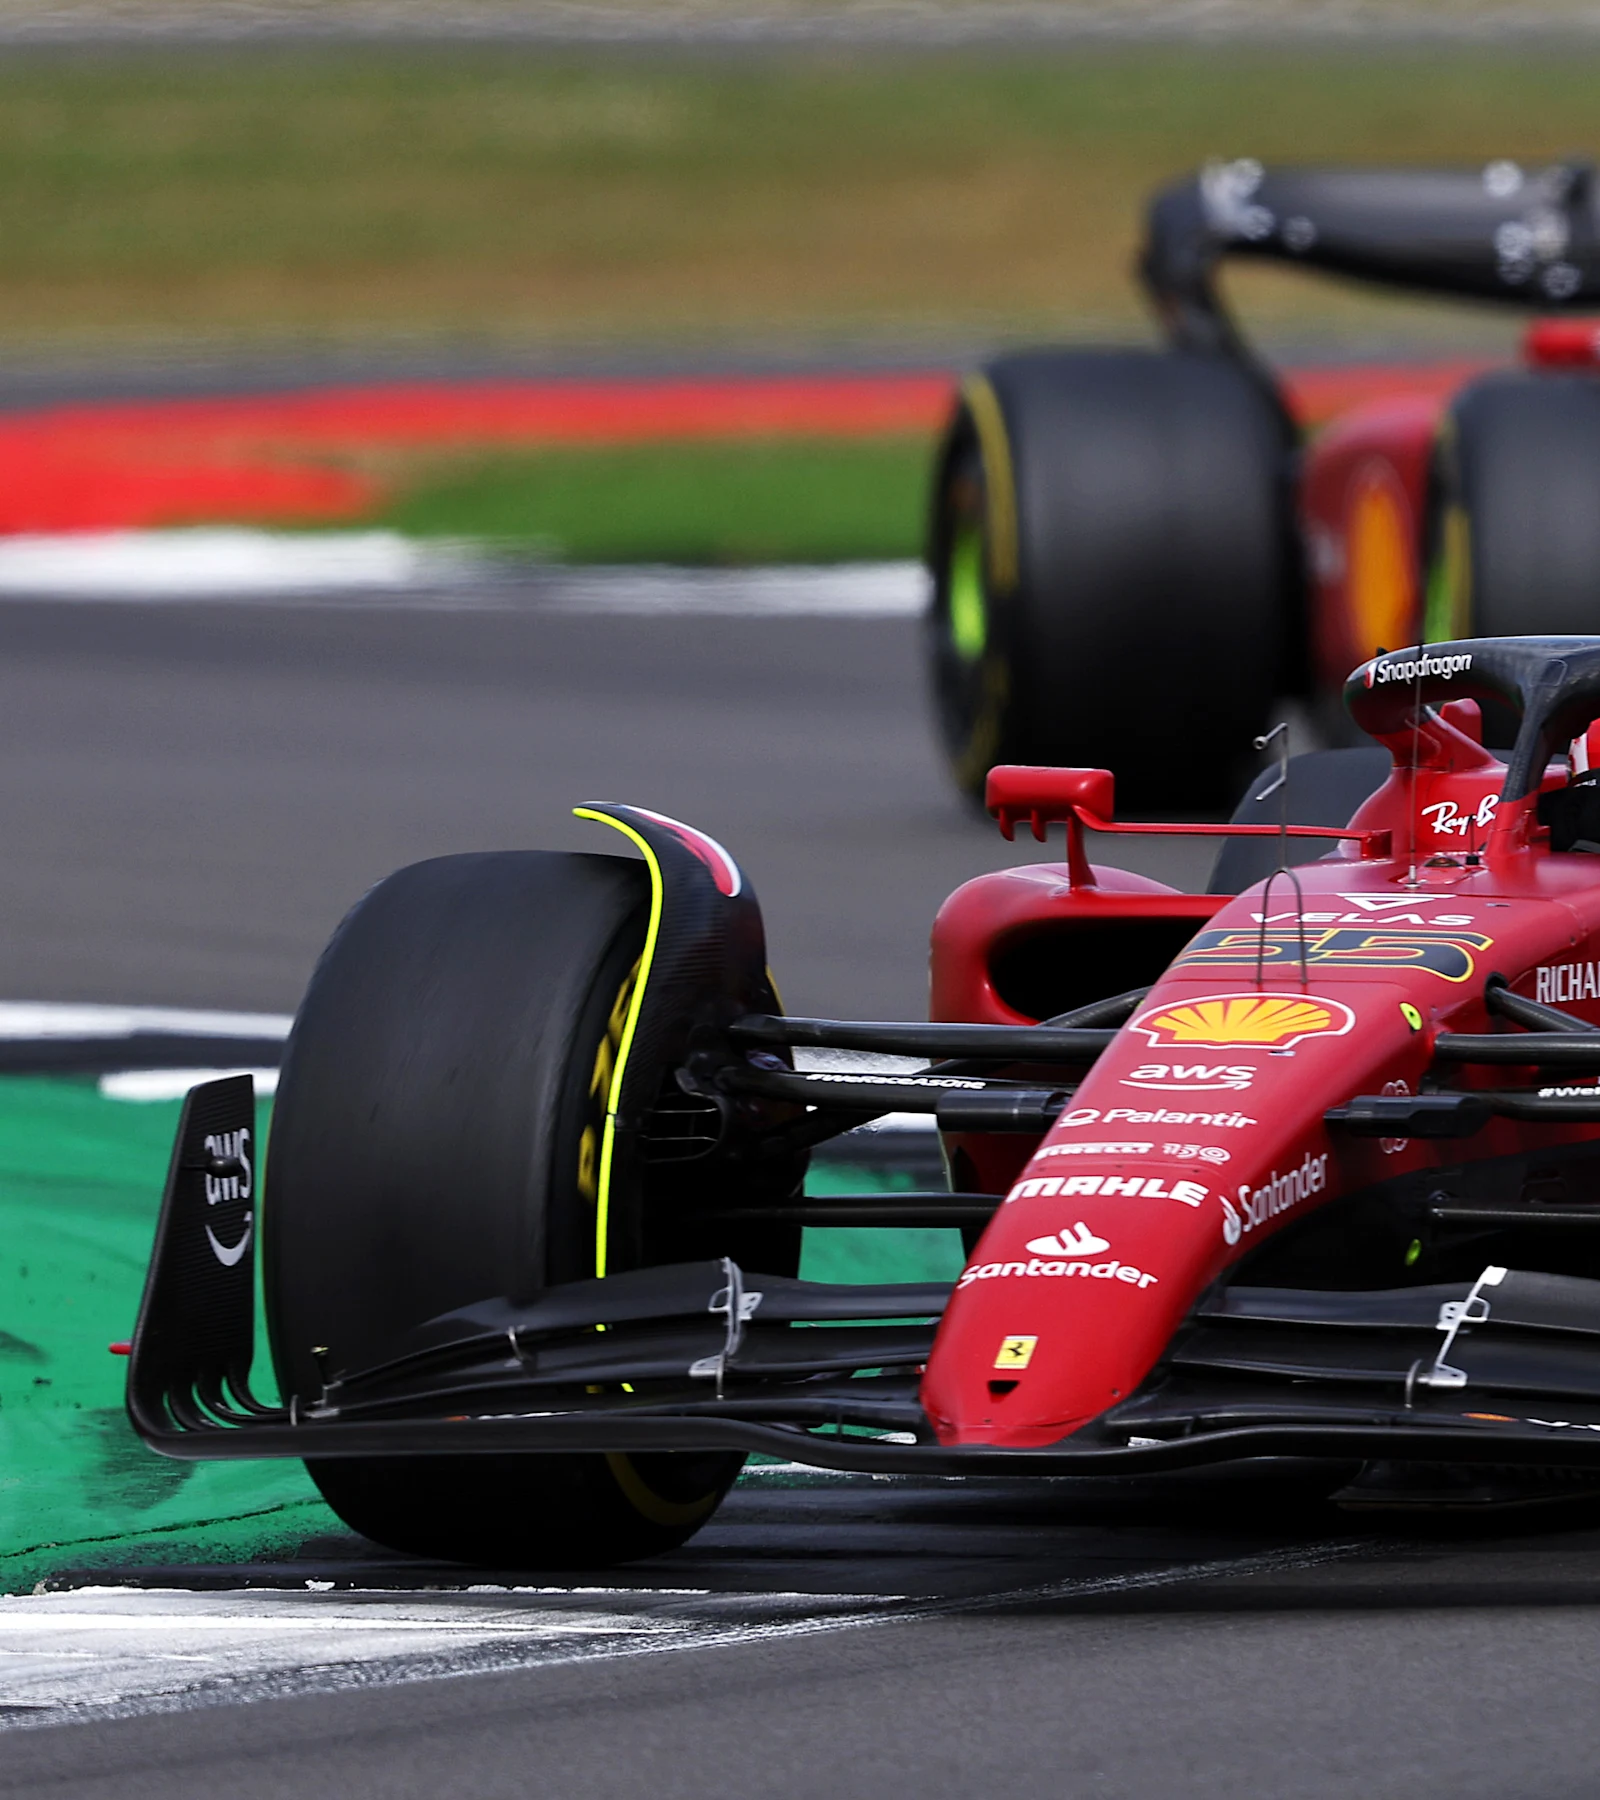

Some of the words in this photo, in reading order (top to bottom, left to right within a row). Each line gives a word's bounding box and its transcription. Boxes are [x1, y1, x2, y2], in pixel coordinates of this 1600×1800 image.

[1376, 653, 1473, 684] Snapdragon
[1250, 912, 1475, 926] VELAS
[1168, 928, 1494, 982] 55
[1129, 1064, 1257, 1080] aws
[1102, 1109, 1257, 1128] Palantir
[204, 1127, 251, 1205] aws
[1006, 1176, 1209, 1208] MAHLE
[1237, 1152, 1328, 1233] Santander
[957, 1259, 1158, 1288] Santander
